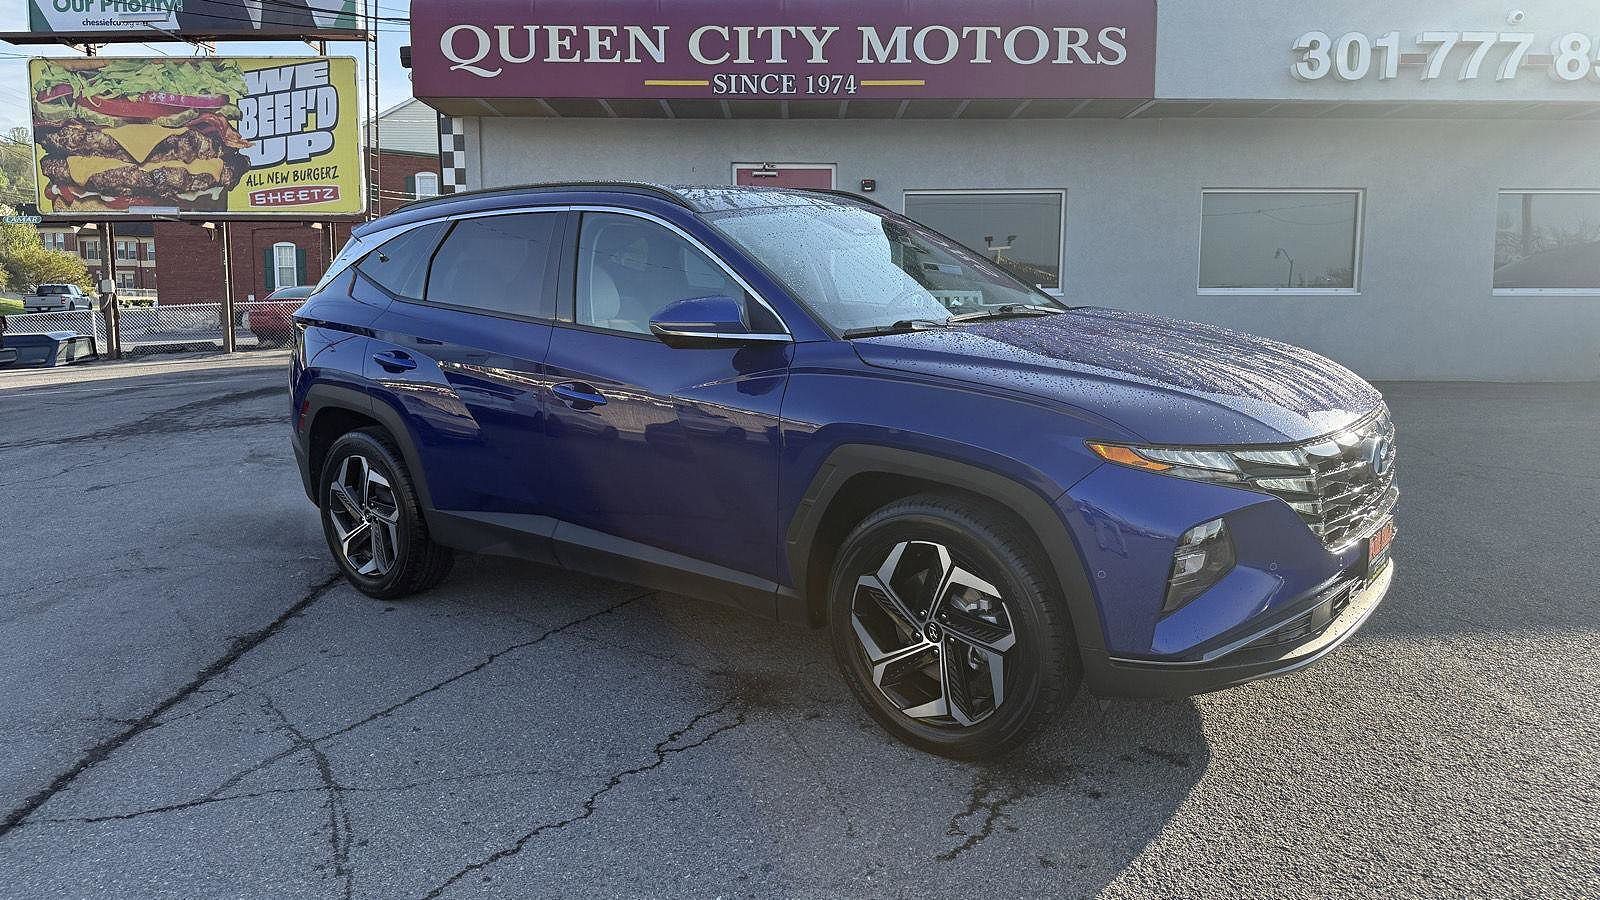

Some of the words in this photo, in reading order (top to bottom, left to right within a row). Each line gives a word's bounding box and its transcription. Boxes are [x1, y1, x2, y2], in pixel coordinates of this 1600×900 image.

[53, 0, 94, 12] Our
[440, 24, 670, 78] QUEEN
[688, 24, 840, 65] CITY
[857, 25, 1128, 66] MOTORS
[243, 59, 330, 96] WE
[712, 73, 797, 95] SINCE
[805, 73, 858, 95] 1974
[237, 85, 339, 139] BEEF'D
[239, 131, 335, 170] UP
[246, 172, 264, 187] ALL
[267, 170, 290, 184] NEW
[292, 166, 340, 182] BURGERZ
[255, 188, 335, 205] SHEETZ
